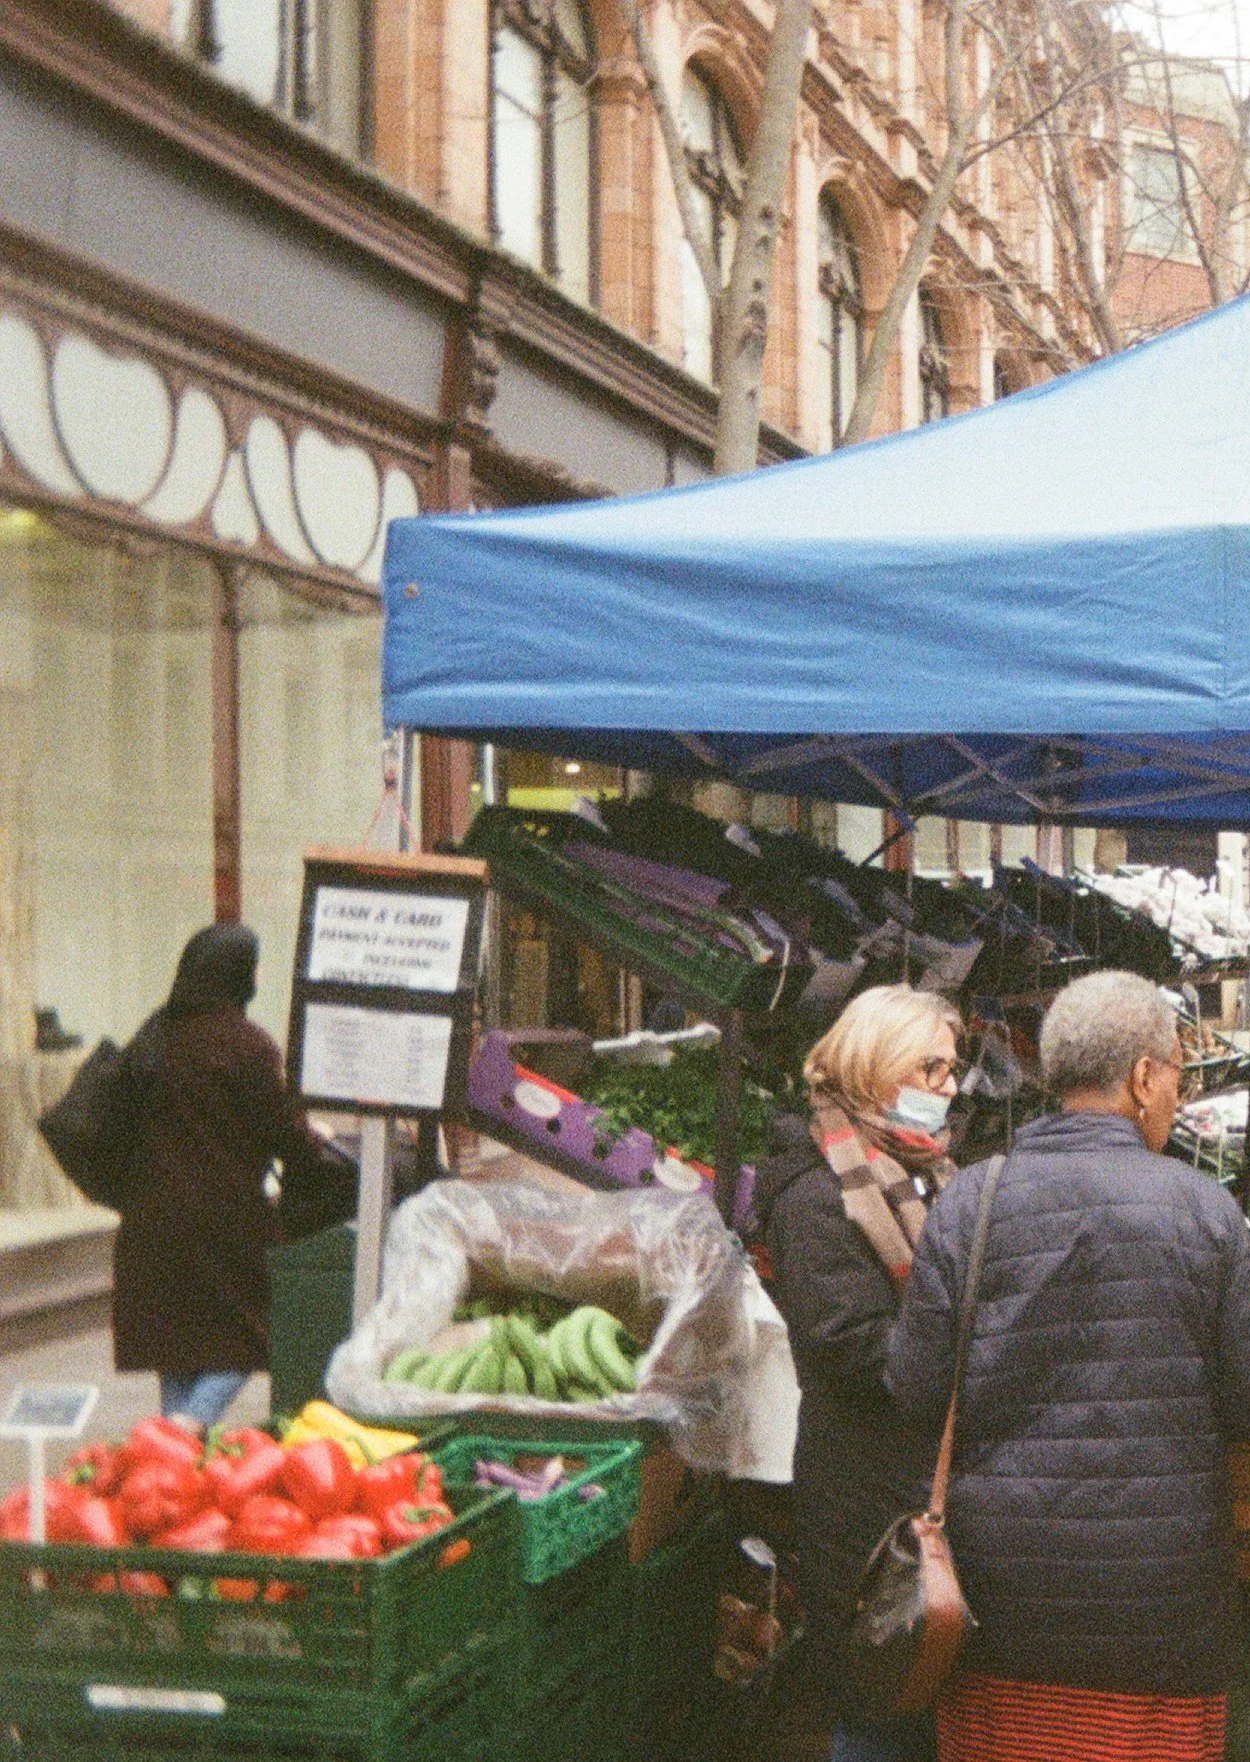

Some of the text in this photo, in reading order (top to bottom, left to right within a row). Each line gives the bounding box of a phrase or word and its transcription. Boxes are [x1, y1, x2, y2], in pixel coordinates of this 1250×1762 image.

[322, 904, 443, 928] CASH & CARD
[318, 927, 380, 945] PAYMENT
